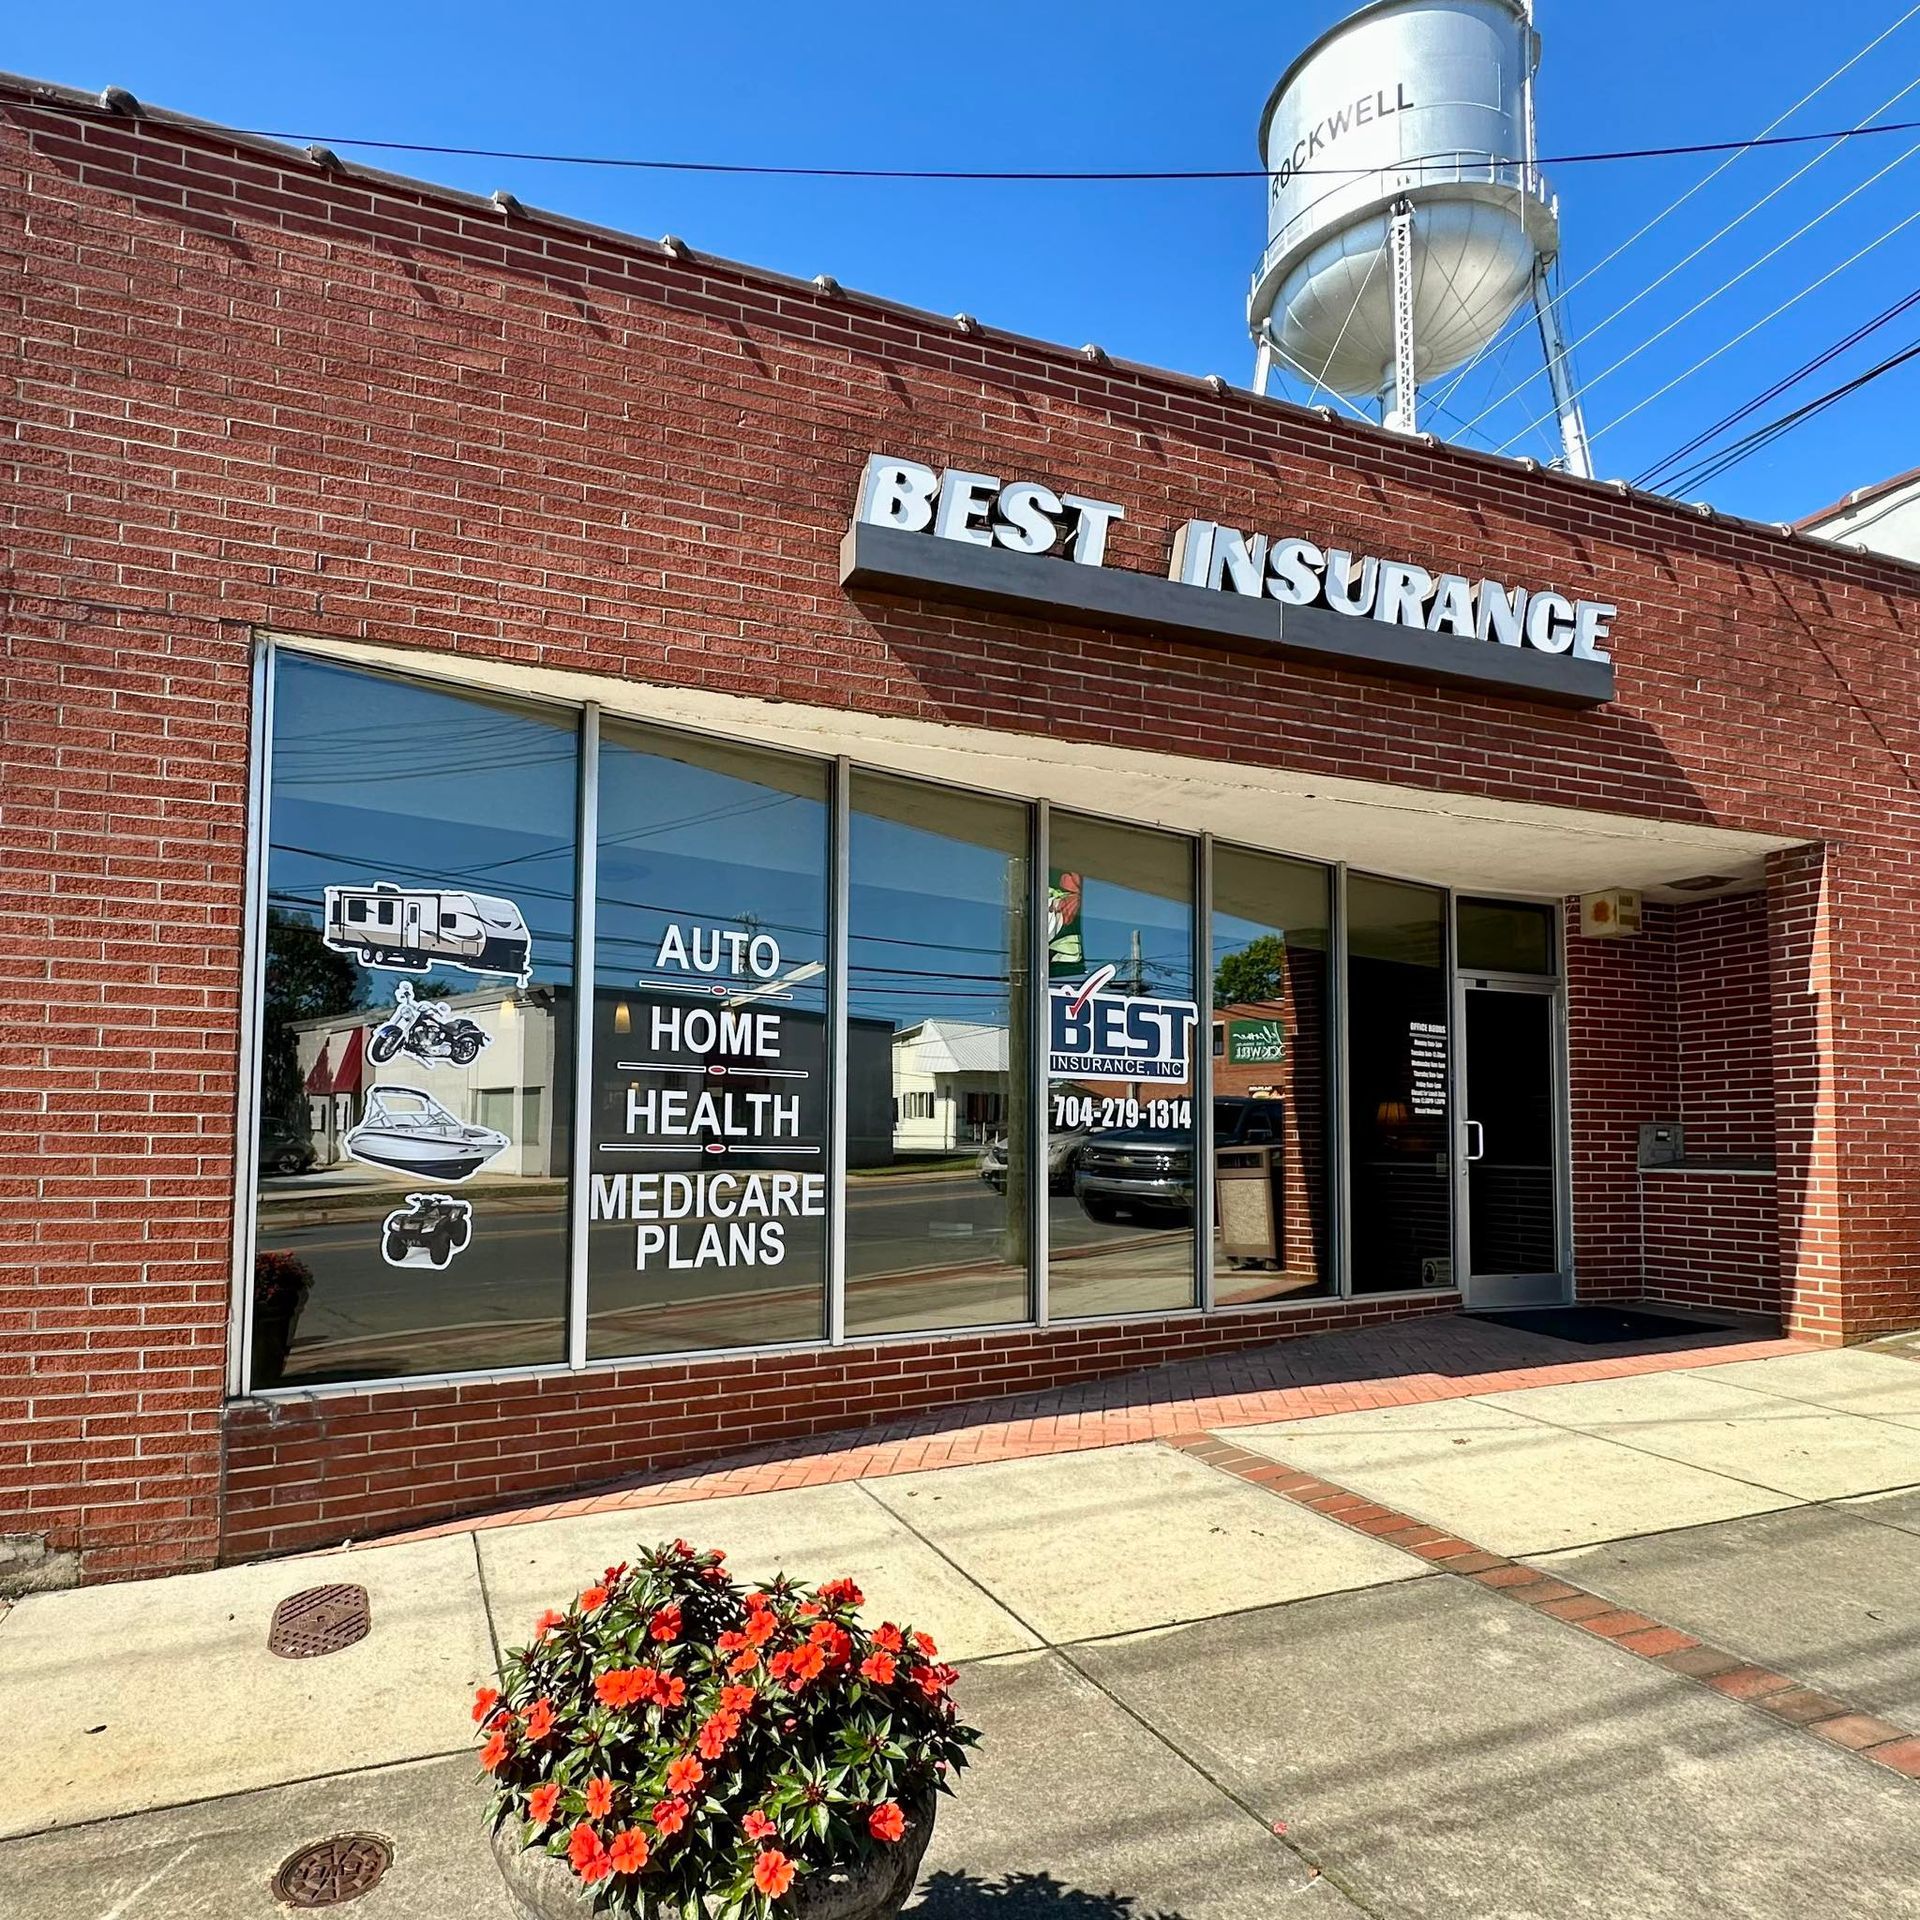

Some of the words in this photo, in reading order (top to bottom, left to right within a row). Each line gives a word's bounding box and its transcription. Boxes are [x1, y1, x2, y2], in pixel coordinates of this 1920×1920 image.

[1272, 83, 1414, 207] ROCKWELL
[856, 453, 1124, 567] BEST
[1172, 519, 1618, 664] INSURANCE
[655, 924, 780, 979] AUTO
[651, 1006, 780, 1058] HOME
[1050, 996, 1193, 1060] BEST
[1052, 1056, 1151, 1076] INSURANCE,
[1156, 1062, 1182, 1077] INC
[626, 1088, 799, 1137] HEALTH
[1054, 1095, 1192, 1129] 704-279-1314
[590, 1173, 825, 1220] MEDICARE
[636, 1222, 785, 1271] PLANS
